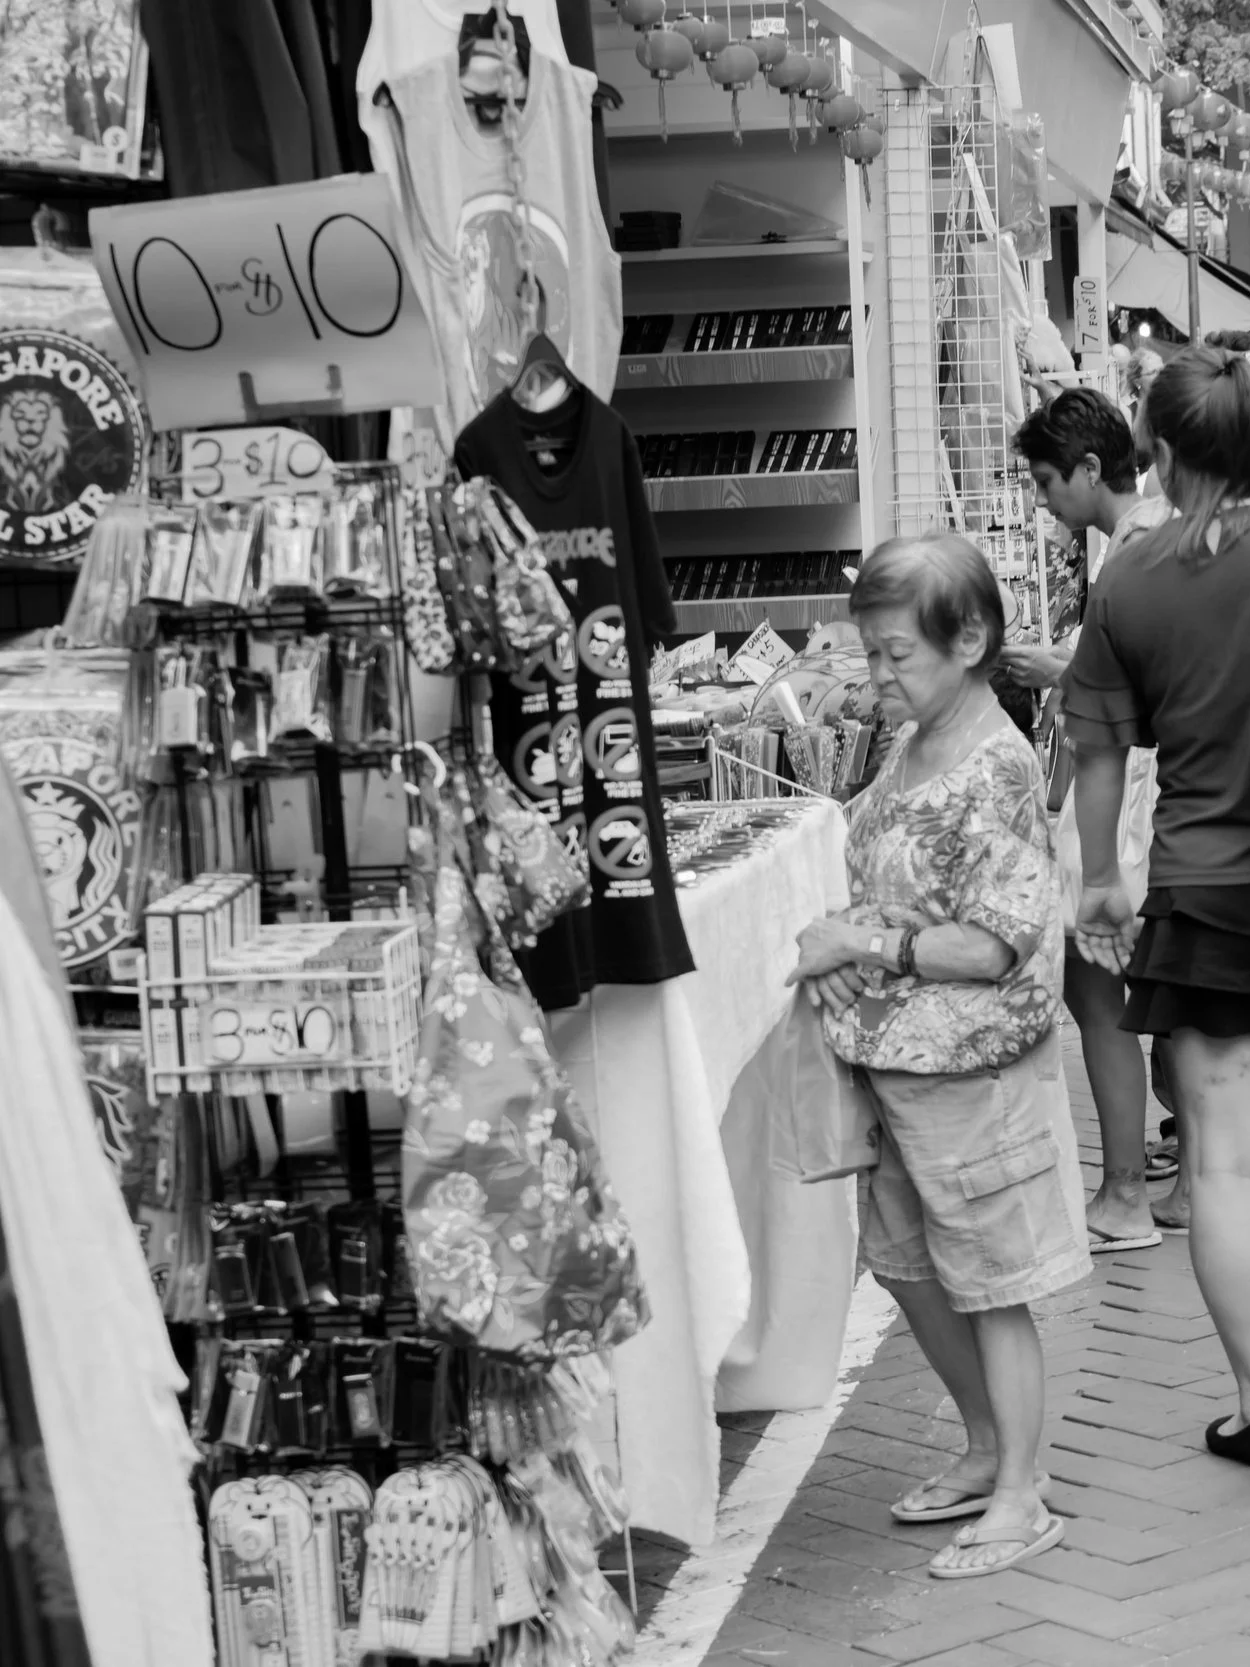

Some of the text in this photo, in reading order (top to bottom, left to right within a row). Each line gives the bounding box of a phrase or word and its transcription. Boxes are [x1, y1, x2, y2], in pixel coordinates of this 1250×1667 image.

[109, 238, 222, 355] 10
[241, 213, 403, 339] $10
[1081, 332, 1098, 346] 7
[1088, 306, 1097, 326] FOR
[192, 438, 224, 498] 3
[244, 432, 325, 487] $10
[209, 1006, 244, 1063] 3
[269, 1005, 336, 1057] $10
